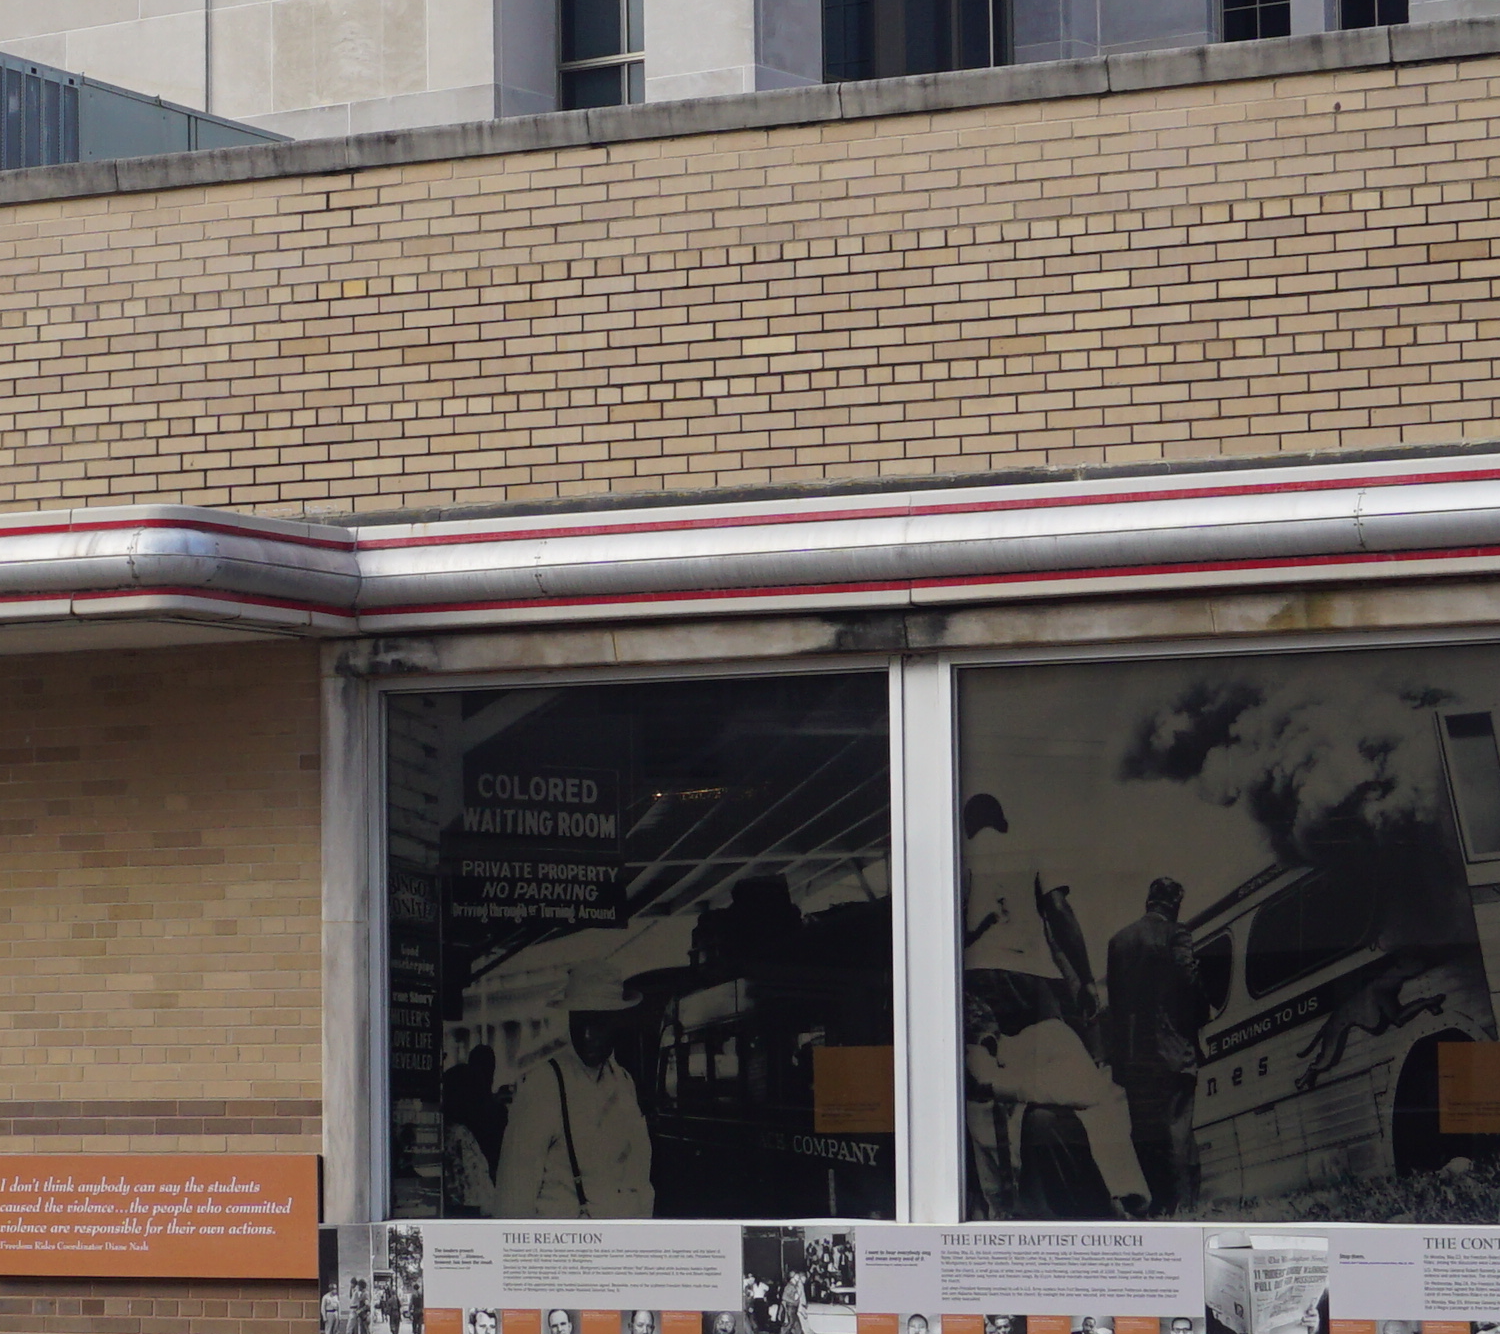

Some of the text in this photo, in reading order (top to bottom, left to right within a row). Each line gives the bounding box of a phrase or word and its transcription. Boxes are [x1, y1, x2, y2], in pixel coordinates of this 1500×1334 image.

[477, 773, 599, 804] COLORED
[463, 808, 616, 839] WAITING ROOM
[461, 859, 619, 883] PRIVATE PROPERTY
[482, 881, 599, 901] NO PARKING
[578, 905, 616, 920] Around
[1222, 996, 1318, 1050] DRIVING TO US
[415, 1032, 432, 1050] LIFE
[793, 1135, 879, 1166] COMPANY
[0, 1176, 260, 1195] I don't think anybody can say the students
[0, 1197, 42, 1213] caused
[44, 1197, 63, 1213] the
[152, 1198, 193, 1217] people
[197, 1198, 223, 1214] who
[225, 1197, 292, 1214] committed
[0, 1217, 276, 1237] violence are responsible for their own actions.
[0, 1240, 149, 1251] Freedom Rides Coordinator Diane Nash
[502, 1232, 603, 1245] THE REACTION
[941, 1234, 1143, 1247] THE FIRST BAPTIST CHURCH
[1423, 1237, 1457, 1250] THE
